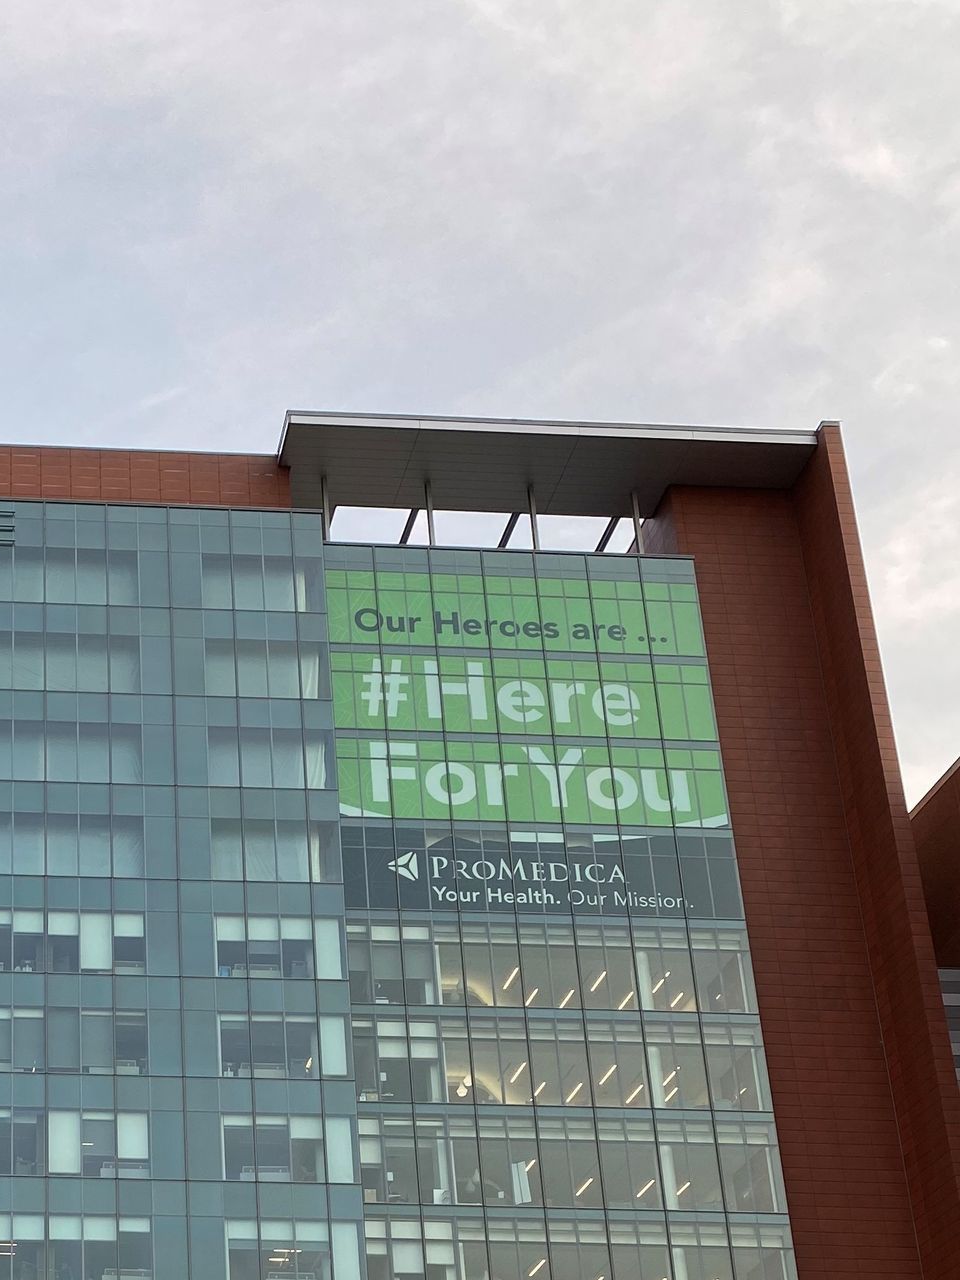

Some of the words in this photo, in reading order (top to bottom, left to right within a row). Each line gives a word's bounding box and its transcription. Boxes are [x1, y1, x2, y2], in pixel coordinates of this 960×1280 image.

[354, 607, 422, 634] Our
[434, 611, 560, 640] Heroes
[572, 620, 627, 642] are
[360, 658, 641, 727] #Here
[430, 856, 630, 884] PROMEDICA
[432, 885, 480, 903] Your
[488, 887, 561, 904] Health.
[567, 889, 607, 907] Our
